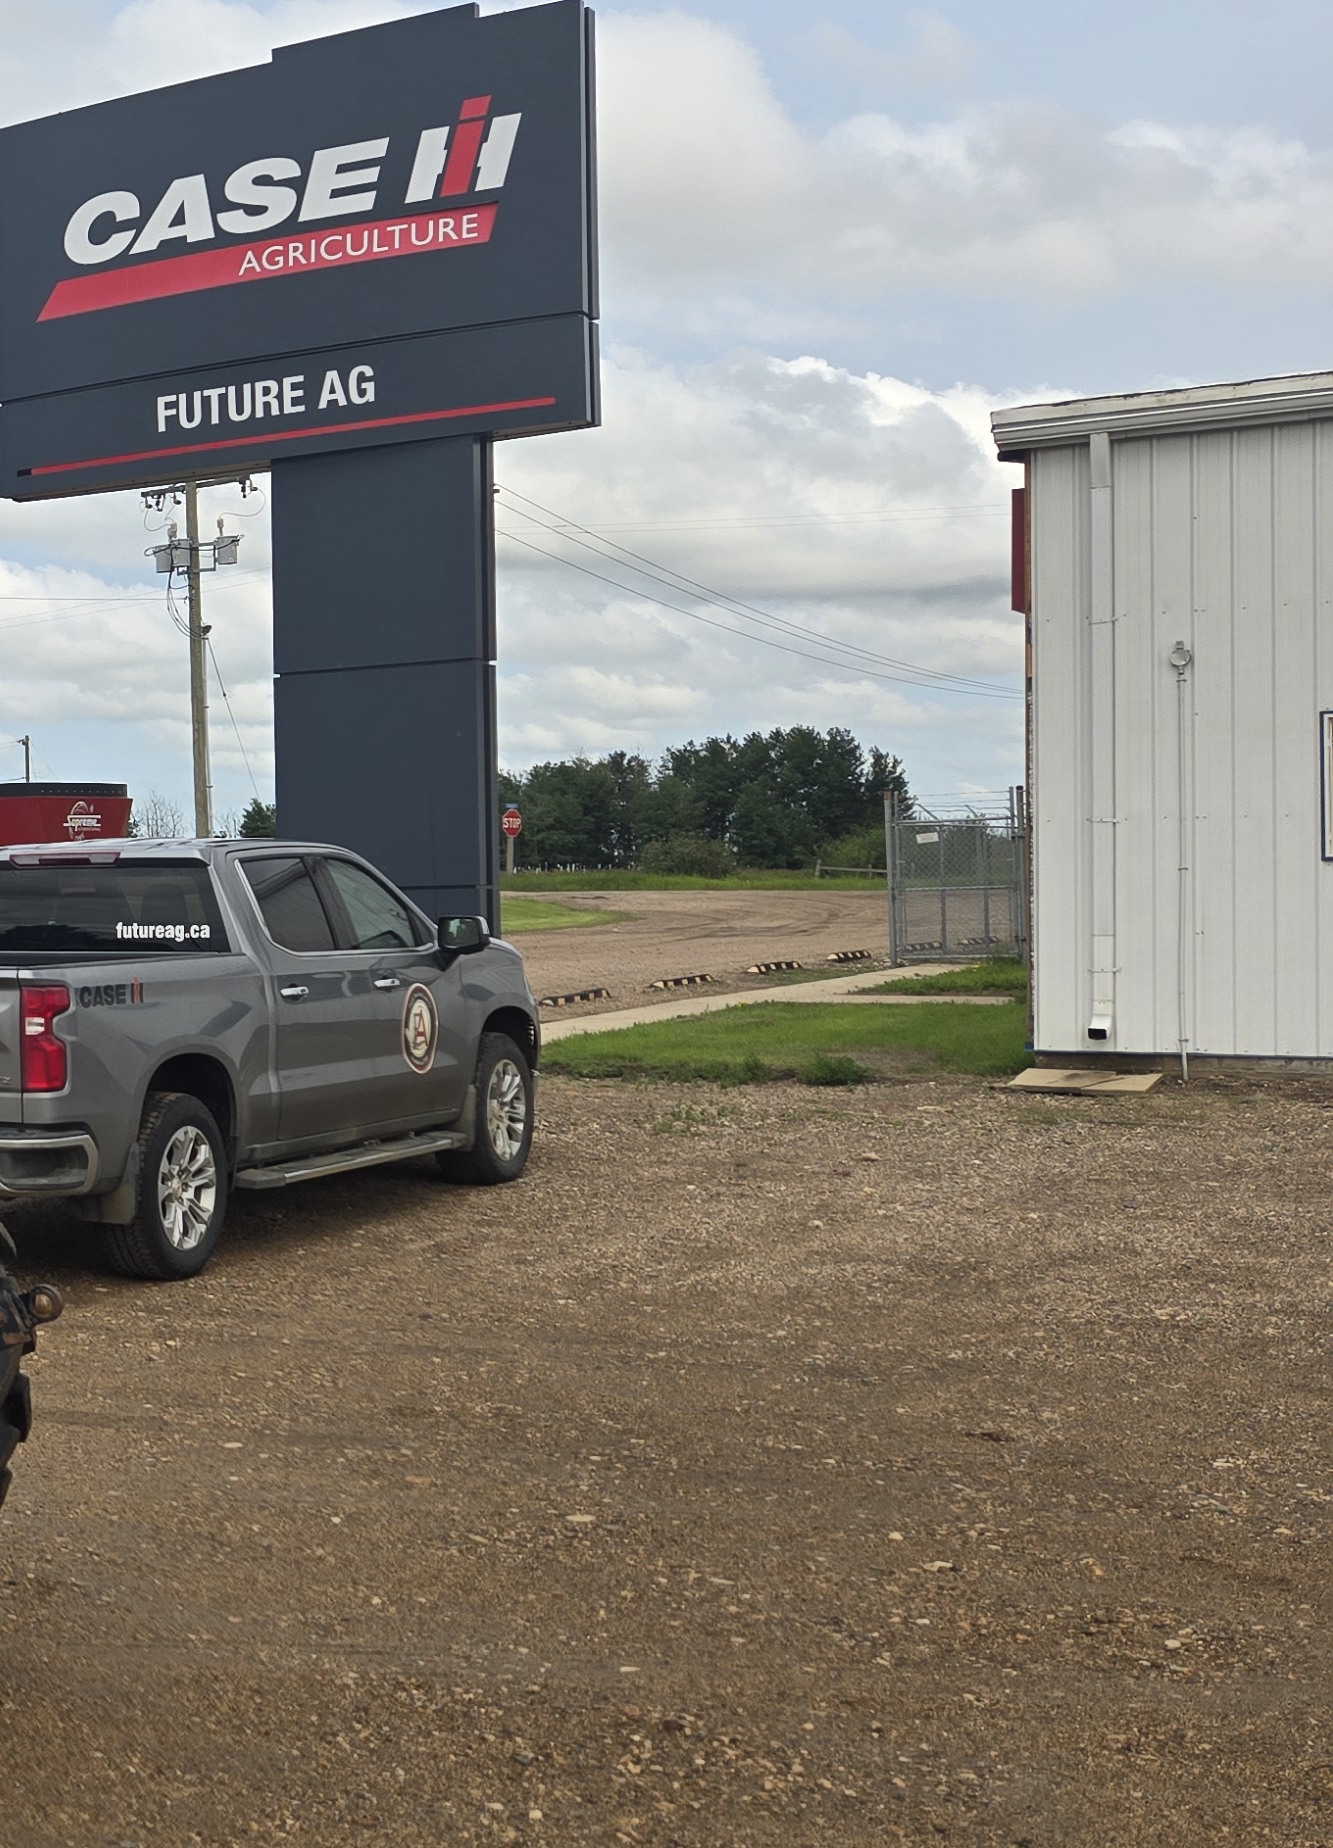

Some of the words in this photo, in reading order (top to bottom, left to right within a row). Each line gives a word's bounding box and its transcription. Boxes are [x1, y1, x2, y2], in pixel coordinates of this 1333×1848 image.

[63, 137, 390, 265] CASE
[238, 213, 480, 276] AGRICULTURE
[156, 375, 306, 433] FUTURE
[318, 365, 376, 410] AG
[503, 817, 521, 829] STOP
[115, 921, 211, 943] futureag.ca
[79, 984, 127, 1009] CASE
